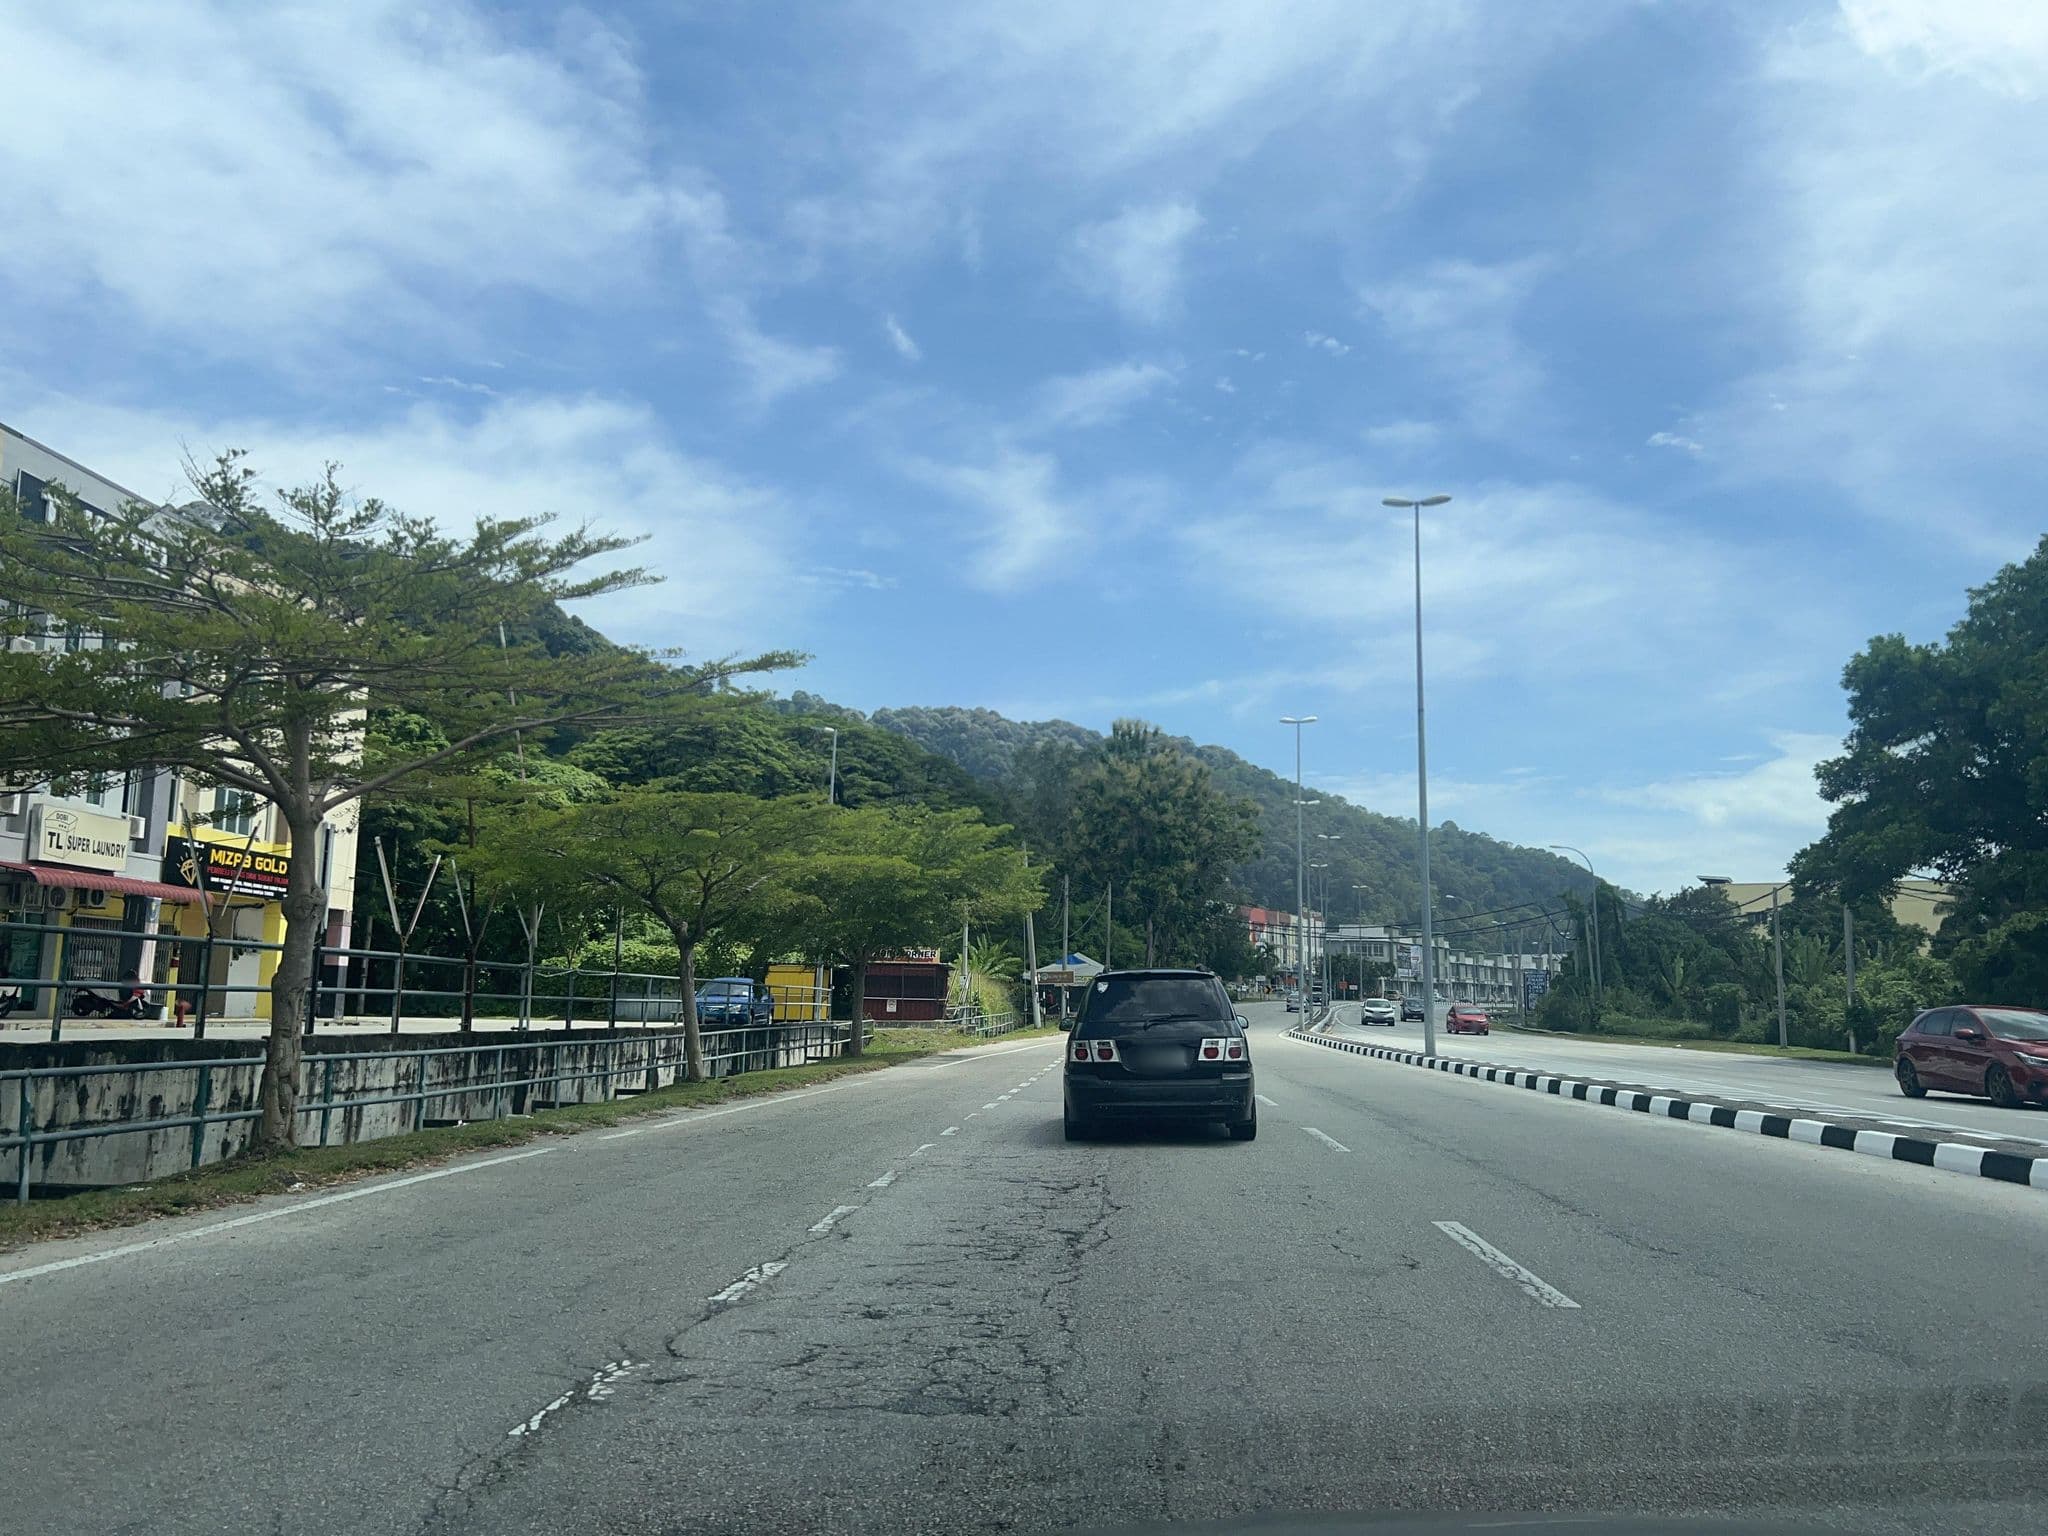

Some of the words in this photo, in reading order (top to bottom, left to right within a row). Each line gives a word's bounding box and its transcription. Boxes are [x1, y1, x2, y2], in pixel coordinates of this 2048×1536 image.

[48, 831, 63, 849] TL
[67, 835, 90, 852] SUPER
[92, 839, 126, 858] LAUNDRY
[255, 857, 287, 874] GOLD
